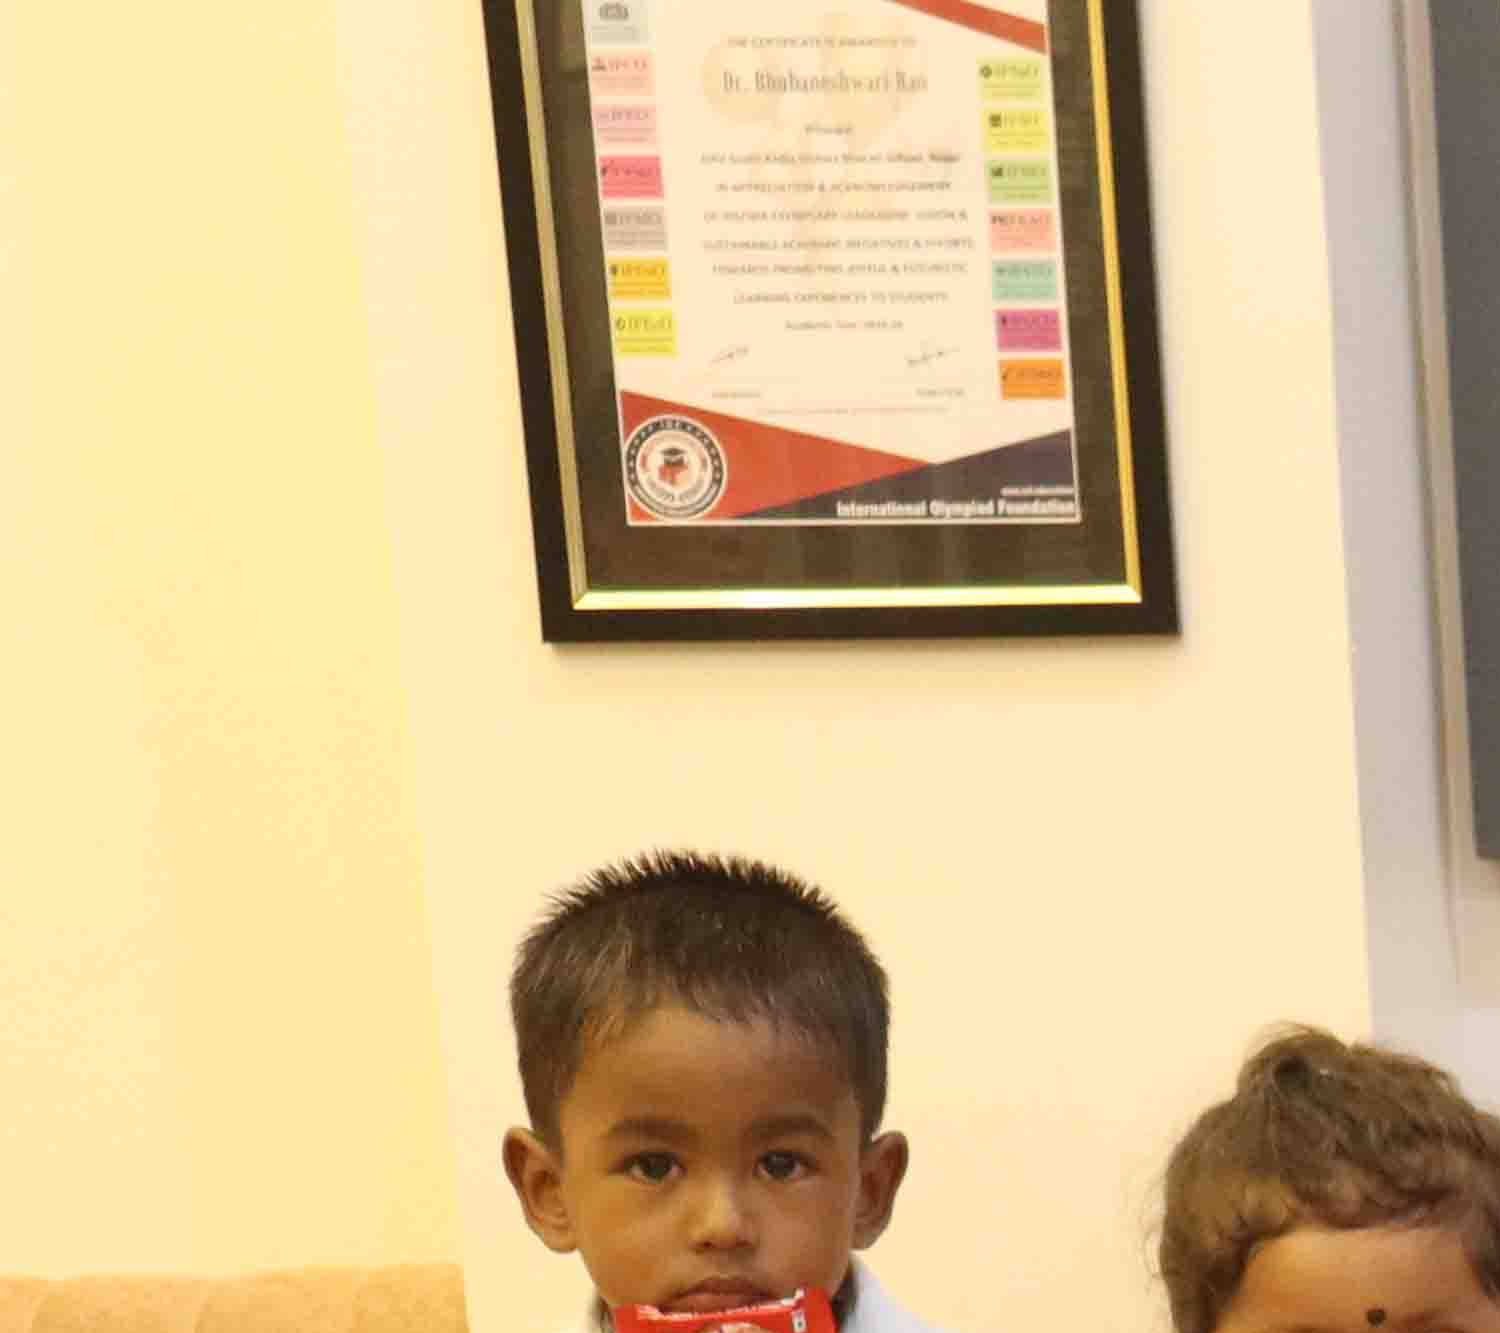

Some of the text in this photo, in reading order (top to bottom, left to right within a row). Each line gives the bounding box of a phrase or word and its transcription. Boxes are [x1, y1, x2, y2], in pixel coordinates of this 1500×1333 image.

[836, 498, 1075, 519] International Olympiad Foundation
